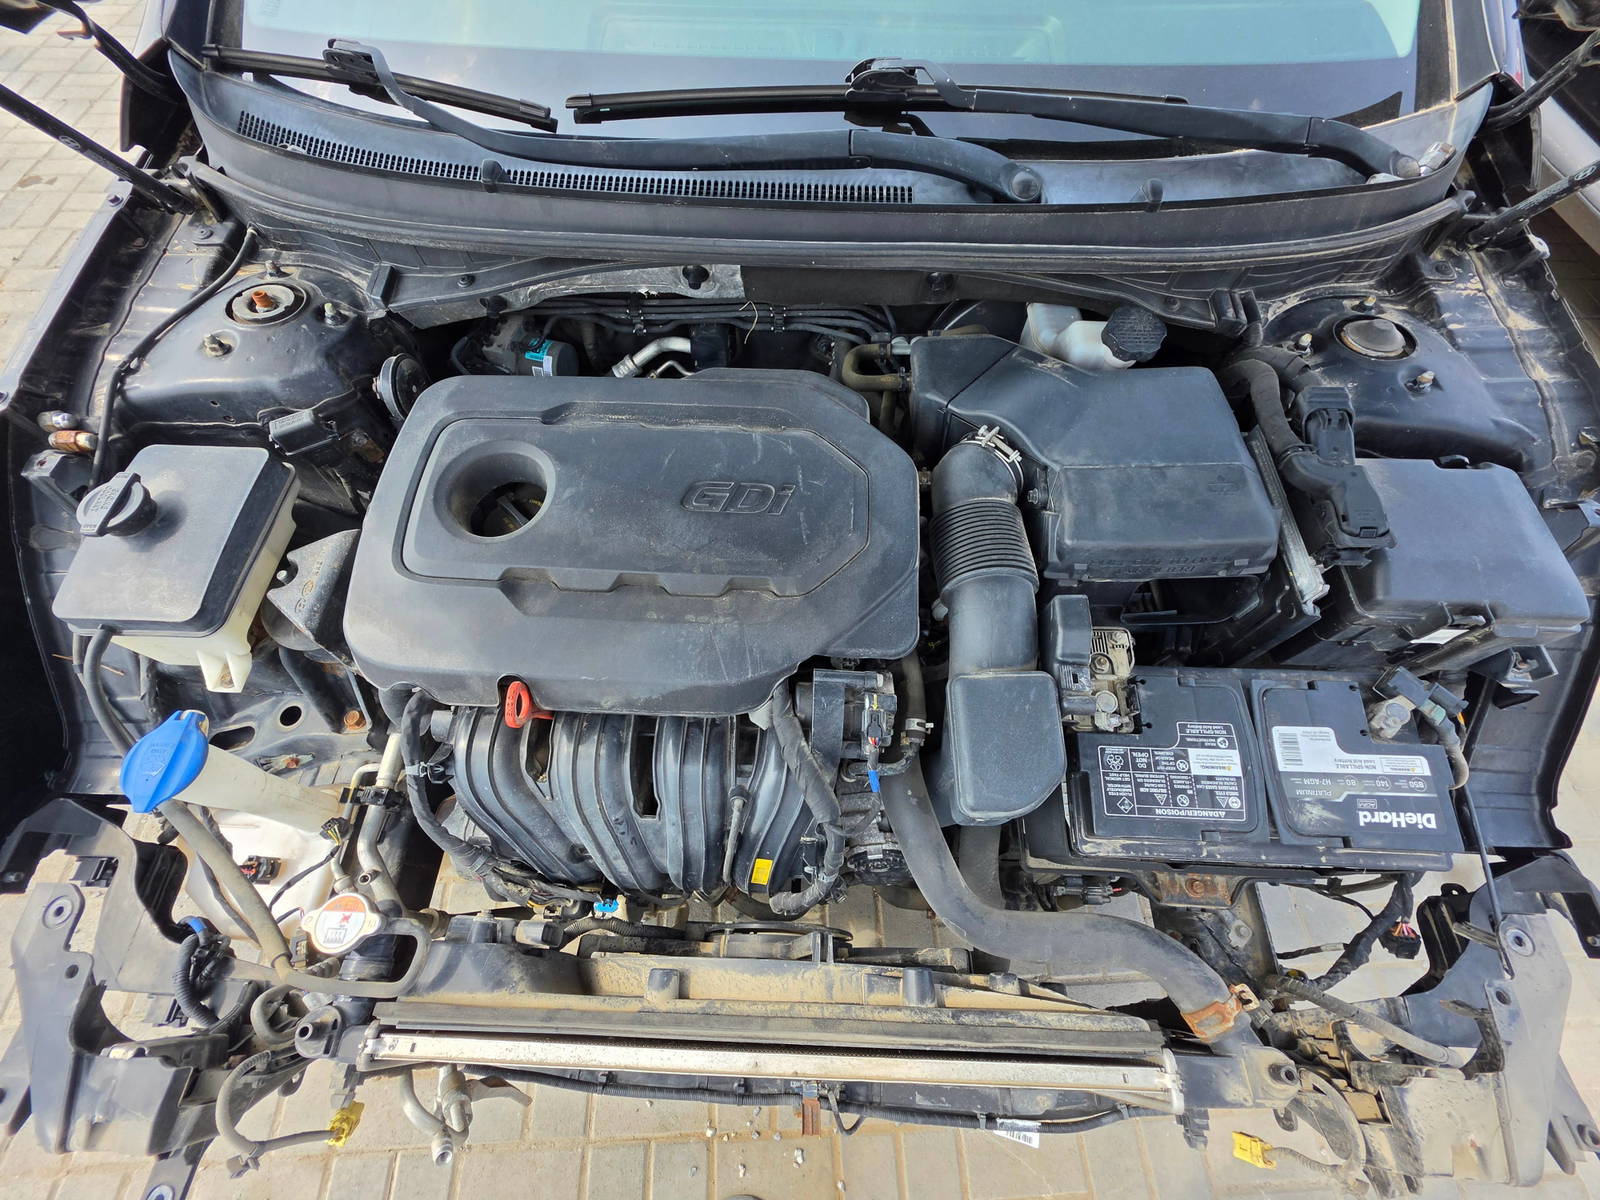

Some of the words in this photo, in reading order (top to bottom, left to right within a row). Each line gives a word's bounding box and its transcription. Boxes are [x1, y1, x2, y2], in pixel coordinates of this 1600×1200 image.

[681, 481, 796, 515] GDi
[1303, 778, 1331, 786] H7-AGM
[1408, 780, 1424, 788] 850
[1295, 789, 1332, 797] PLATINUM
[1155, 808, 1220, 818] DANGER/POISON
[1358, 811, 1437, 829] DieHard
